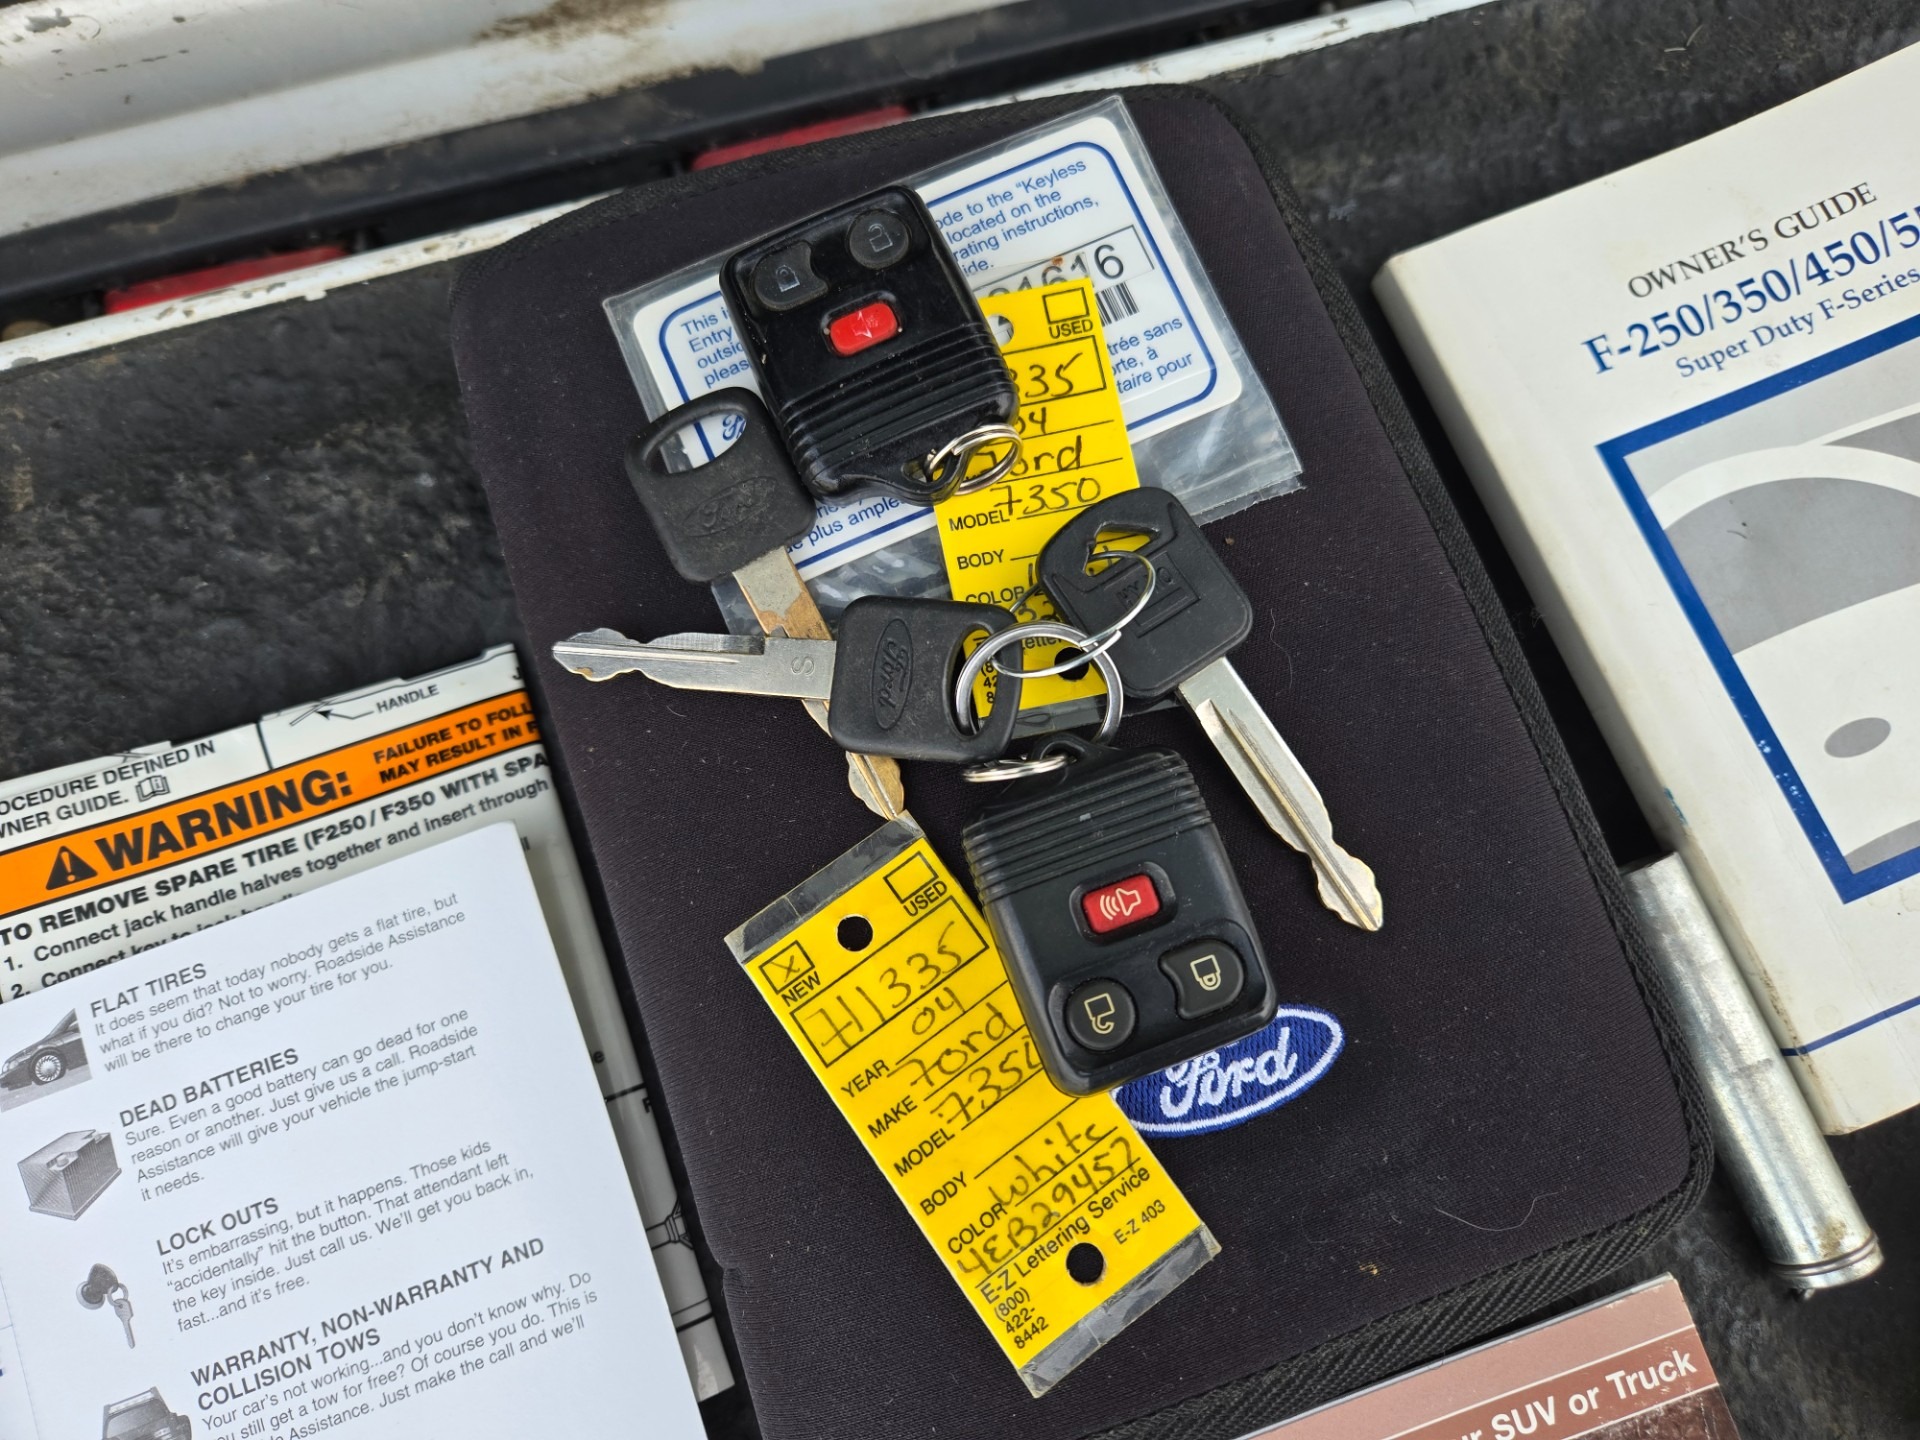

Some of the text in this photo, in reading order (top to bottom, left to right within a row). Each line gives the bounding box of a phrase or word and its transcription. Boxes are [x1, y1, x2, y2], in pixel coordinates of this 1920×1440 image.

[935, 160, 1087, 230] ode to the “Keyless
[945, 188, 1062, 244] located on the
[953, 196, 1099, 264] rating instructions,
[1628, 182, 1878, 298] OWNER’S GUIDE
[962, 256, 994, 278] ide.
[681, 313, 719, 336] This
[688, 326, 733, 353] Entry
[1048, 319, 1094, 339] USED
[1107, 317, 1183, 356] trée sans
[1676, 268, 1920, 378] Super Duty F-Series
[703, 360, 750, 389] pleas
[1112, 346, 1159, 377] orte, à
[1116, 352, 1193, 395] taire pour
[807, 525, 843, 546] plus
[847, 497, 900, 525] ample
[948, 509, 1010, 532] MODEL
[957, 549, 1004, 570] BODY
[375, 683, 440, 713] HANDLE
[372, 727, 453, 765] FAILURE
[454, 716, 483, 736] TO
[378, 758, 420, 784] MAY
[424, 734, 496, 768] RESULT
[500, 725, 523, 742] IN
[0, 739, 216, 816] OCEDURE DEFINED IN
[55, 789, 129, 821] GUIDE.
[94, 769, 353, 873] WARNING:
[0, 922, 33, 946] TO
[38, 885, 150, 934] REMOVE
[153, 857, 238, 897] SPARE
[240, 837, 296, 868] TIRE
[303, 814, 367, 852] (F250
[379, 790, 436, 822] F350
[438, 767, 499, 800] WITH
[504, 752, 550, 777] SPA
[3, 955, 24, 972] 1.
[33, 923, 121, 962] Connect
[122, 909, 168, 939] jack
[169, 888, 238, 920] handle
[239, 866, 304, 896] halves
[304, 836, 383, 874] together
[386, 821, 422, 846] and
[422, 802, 477, 833] insert
[478, 778, 549, 807] through
[902, 880, 948, 917] USED
[94, 892, 459, 1037] It does seem that today nobody gets a flat tire, but
[781, 970, 821, 1008] NEW
[89, 962, 207, 1019] FLAT TIRES
[118, 1047, 299, 1128] DEAD BATTERIES
[841, 1059, 890, 1098] YEAR
[1159, 1026, 1298, 1118] Ford
[136, 1044, 477, 1184] Assistance will give your vehicle the jump-start
[867, 1095, 918, 1139] MAKE
[893, 1128, 956, 1178] MODEL
[140, 1170, 205, 1202] it needs.
[187, 1218, 294, 1266] embarrassing,
[295, 1204, 323, 1225] but
[323, 1199, 336, 1214] it
[336, 1175, 408, 1209] happens.
[408, 1154, 458, 1180] Those
[459, 1140, 492, 1162] kids
[919, 1170, 968, 1217] BODY
[155, 1196, 279, 1257] LOCK OUTS
[947, 1203, 1009, 1255] COLOR
[979, 1166, 1151, 1304] E-Z Lettering Service
[1113, 1199, 1166, 1245] E-Z 403
[274, 1275, 310, 1296] free.
[994, 1286, 1031, 1322] (800)
[189, 1237, 544, 1387] WARRANTY, NON-WARRANTY AND
[1004, 1306, 1037, 1335] 422-
[1013, 1316, 1050, 1350] 8442
[197, 1327, 381, 1411] COLLISION TOWS
[200, 1408, 238, 1431] Your
[282, 1380, 308, 1402] not
[413, 1329, 444, 1354] you
[486, 1295, 527, 1321] know
[530, 1282, 566, 1304] why.
[567, 1271, 592, 1289] Do
[1491, 1349, 1698, 1440] SUV or Truck
